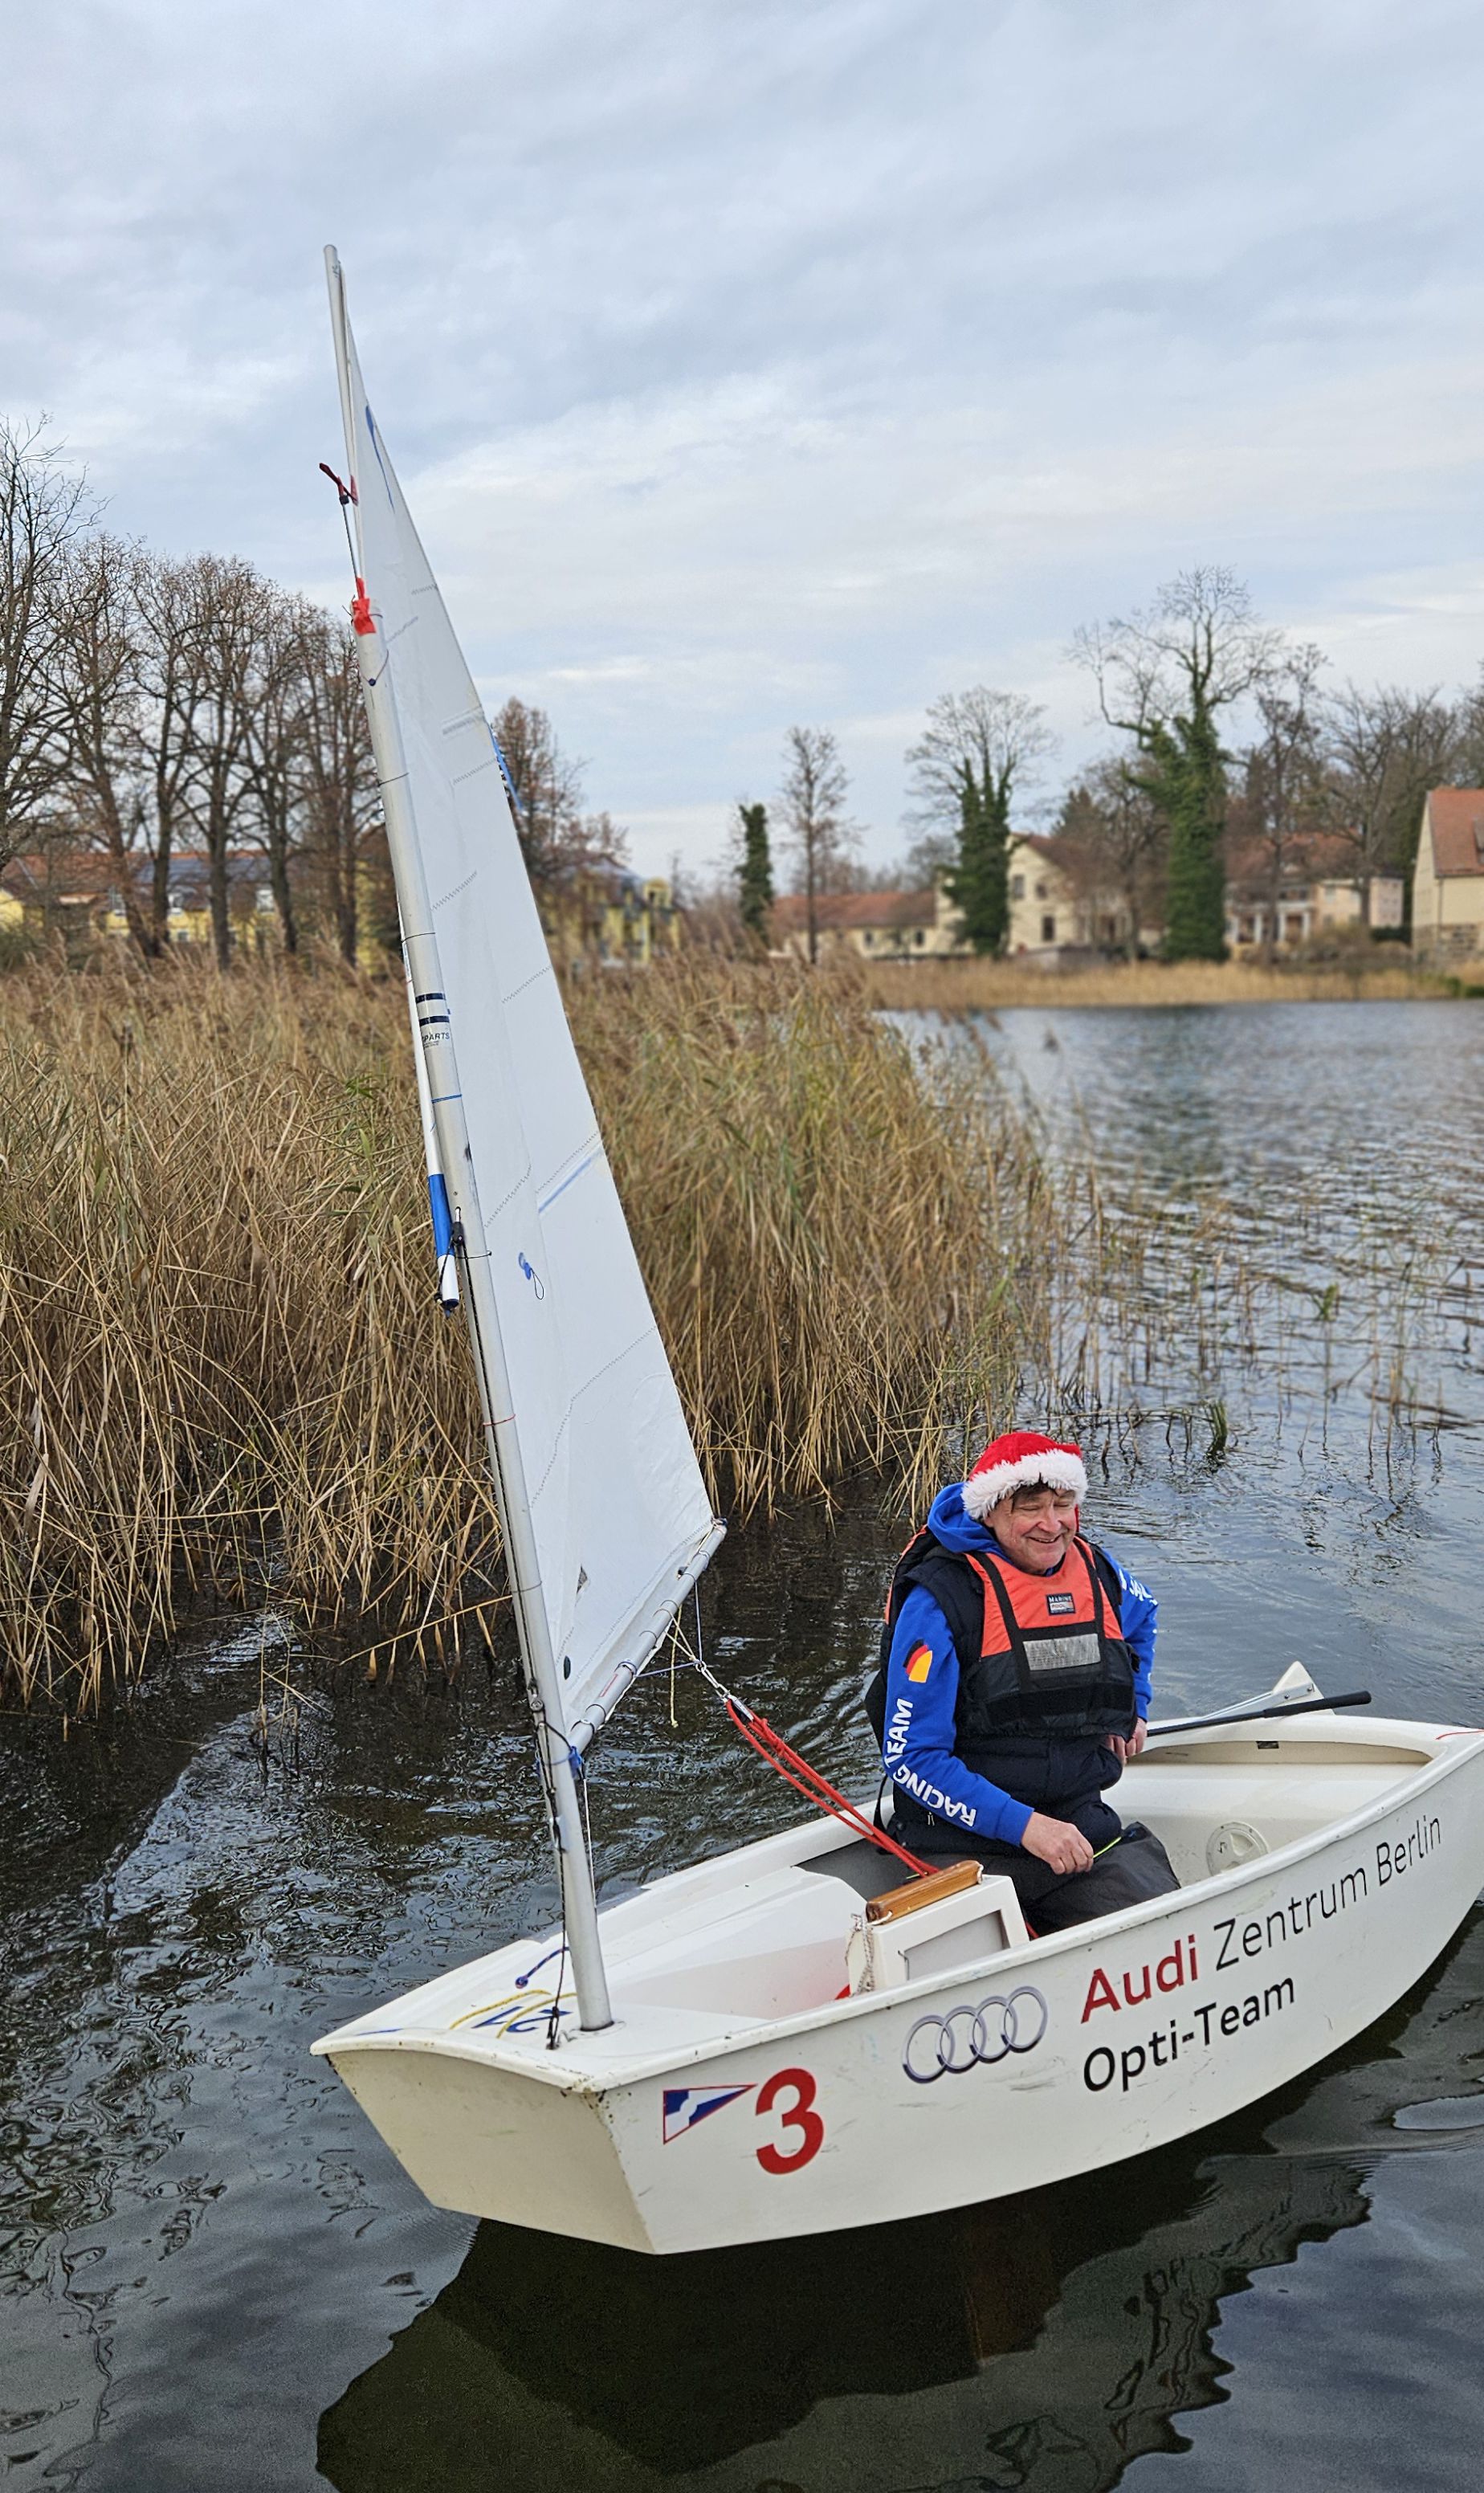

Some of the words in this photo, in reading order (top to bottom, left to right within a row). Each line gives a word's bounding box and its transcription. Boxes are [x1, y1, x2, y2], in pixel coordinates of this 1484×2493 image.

[884, 1698, 913, 1768] TEAM
[892, 1765, 977, 1827] RACING
[1080, 1934, 1199, 2024] Audi
[1213, 1867, 1368, 1971] Zentrum
[1376, 1814, 1442, 1887] Berlin
[1083, 1977, 1295, 2092] Opti-Team
[756, 2068, 824, 2174] 3
